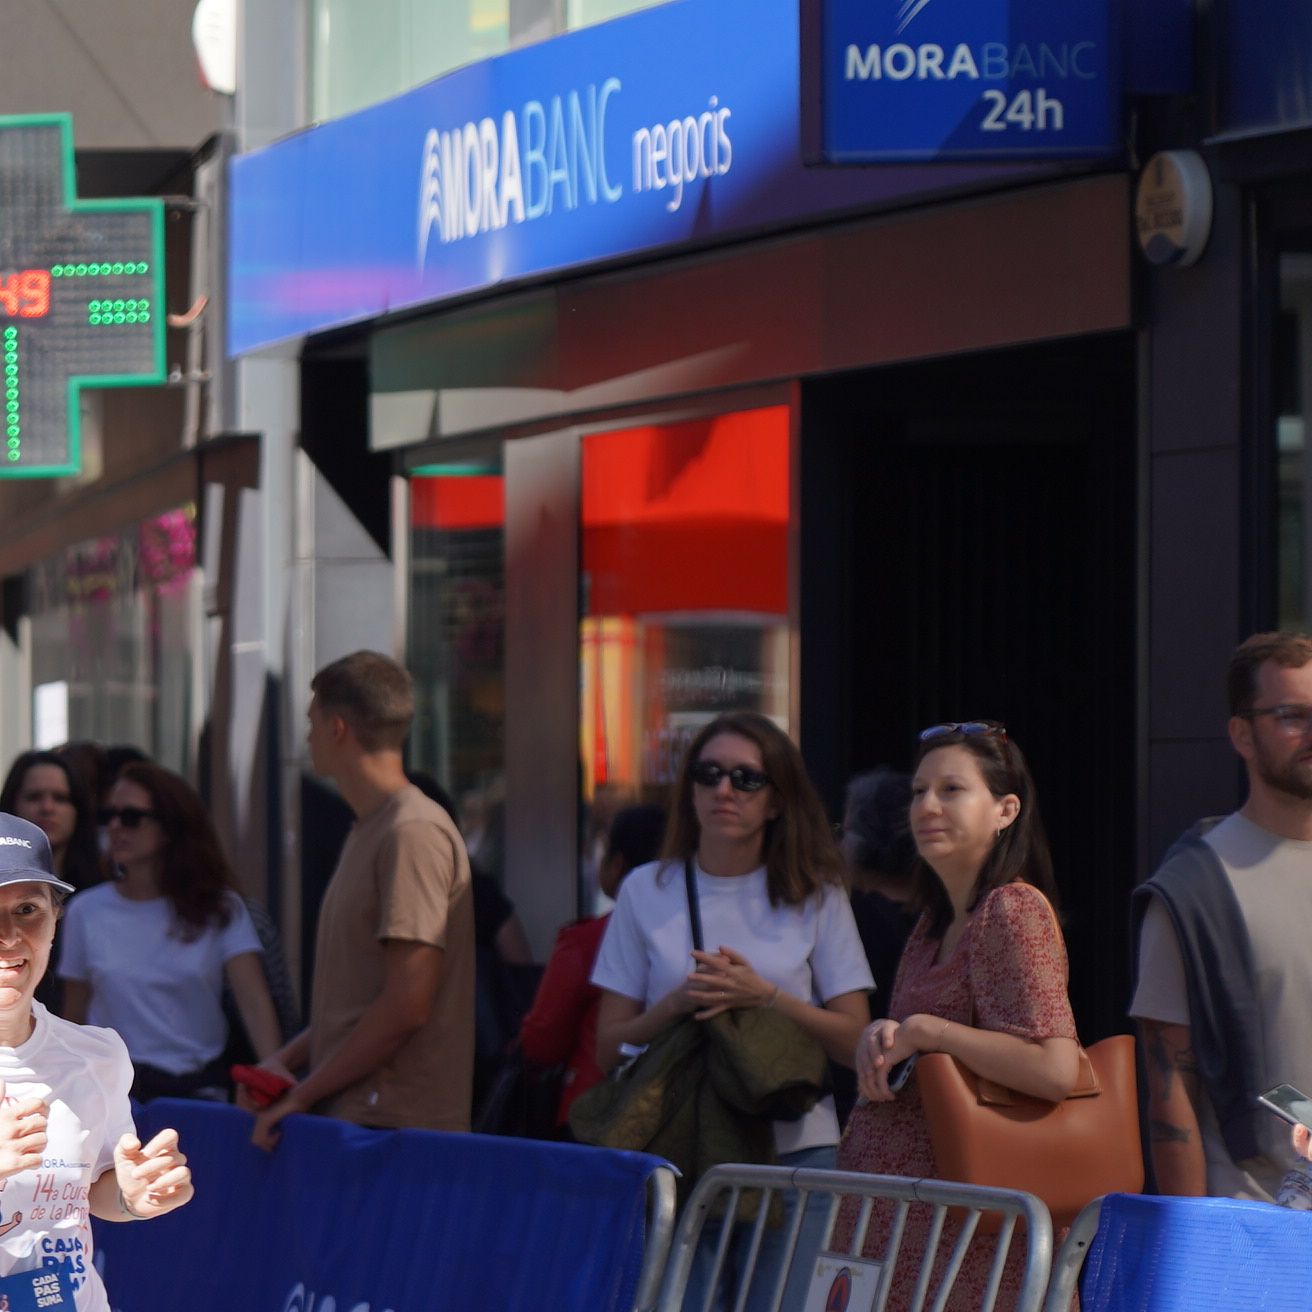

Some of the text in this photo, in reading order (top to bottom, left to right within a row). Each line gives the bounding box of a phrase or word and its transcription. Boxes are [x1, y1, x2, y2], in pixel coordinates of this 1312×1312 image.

[845, 42, 1097, 80] MORABANC
[981, 88, 1064, 131] 24h
[440, 77, 733, 242] MORABANC negocis
[41, 1159, 65, 1168] ORA
[62, 1182, 88, 1200] Curs
[30, 1205, 46, 1220] de
[49, 1204, 64, 1220] la
[32, 1273, 59, 1287] CADA
[34, 1282, 61, 1297] PAS
[37, 1294, 63, 1308] SUMA
